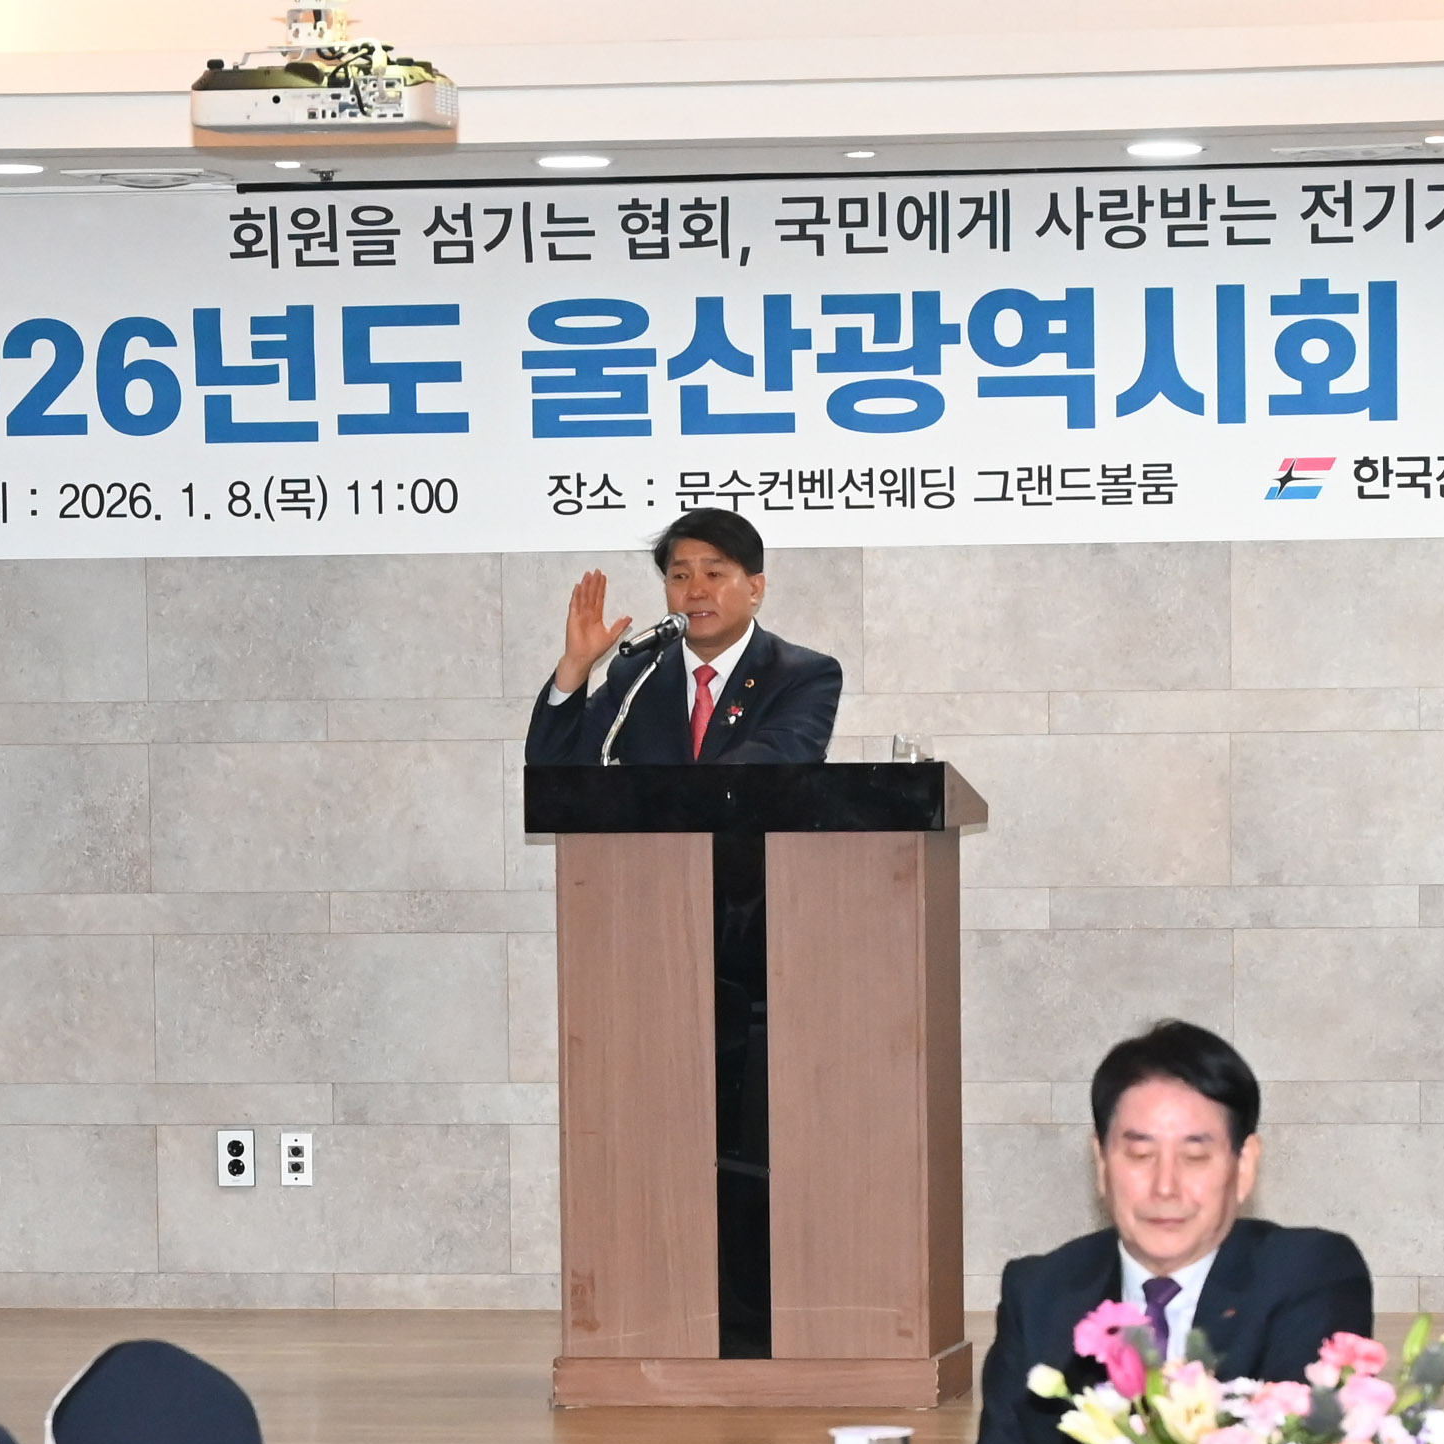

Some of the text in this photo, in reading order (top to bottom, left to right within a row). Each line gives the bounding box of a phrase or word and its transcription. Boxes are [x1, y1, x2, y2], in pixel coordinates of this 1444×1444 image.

[230, 205, 400, 269] 회원을
[423, 202, 595, 264] 섬기는
[618, 196, 750, 266] 협회,
[775, 189, 1010, 255] 국민에게
[1036, 184, 1276, 250] 사랑받는
[522, 278, 1397, 438] 울산광역시회
[59, 483, 161, 520] 2026.
[348, 478, 458, 514] 11:00
[548, 473, 626, 515] 장소
[676, 466, 954, 512] 문수컨벤션웨딩
[974, 464, 1178, 506] 그랜드볼룸
